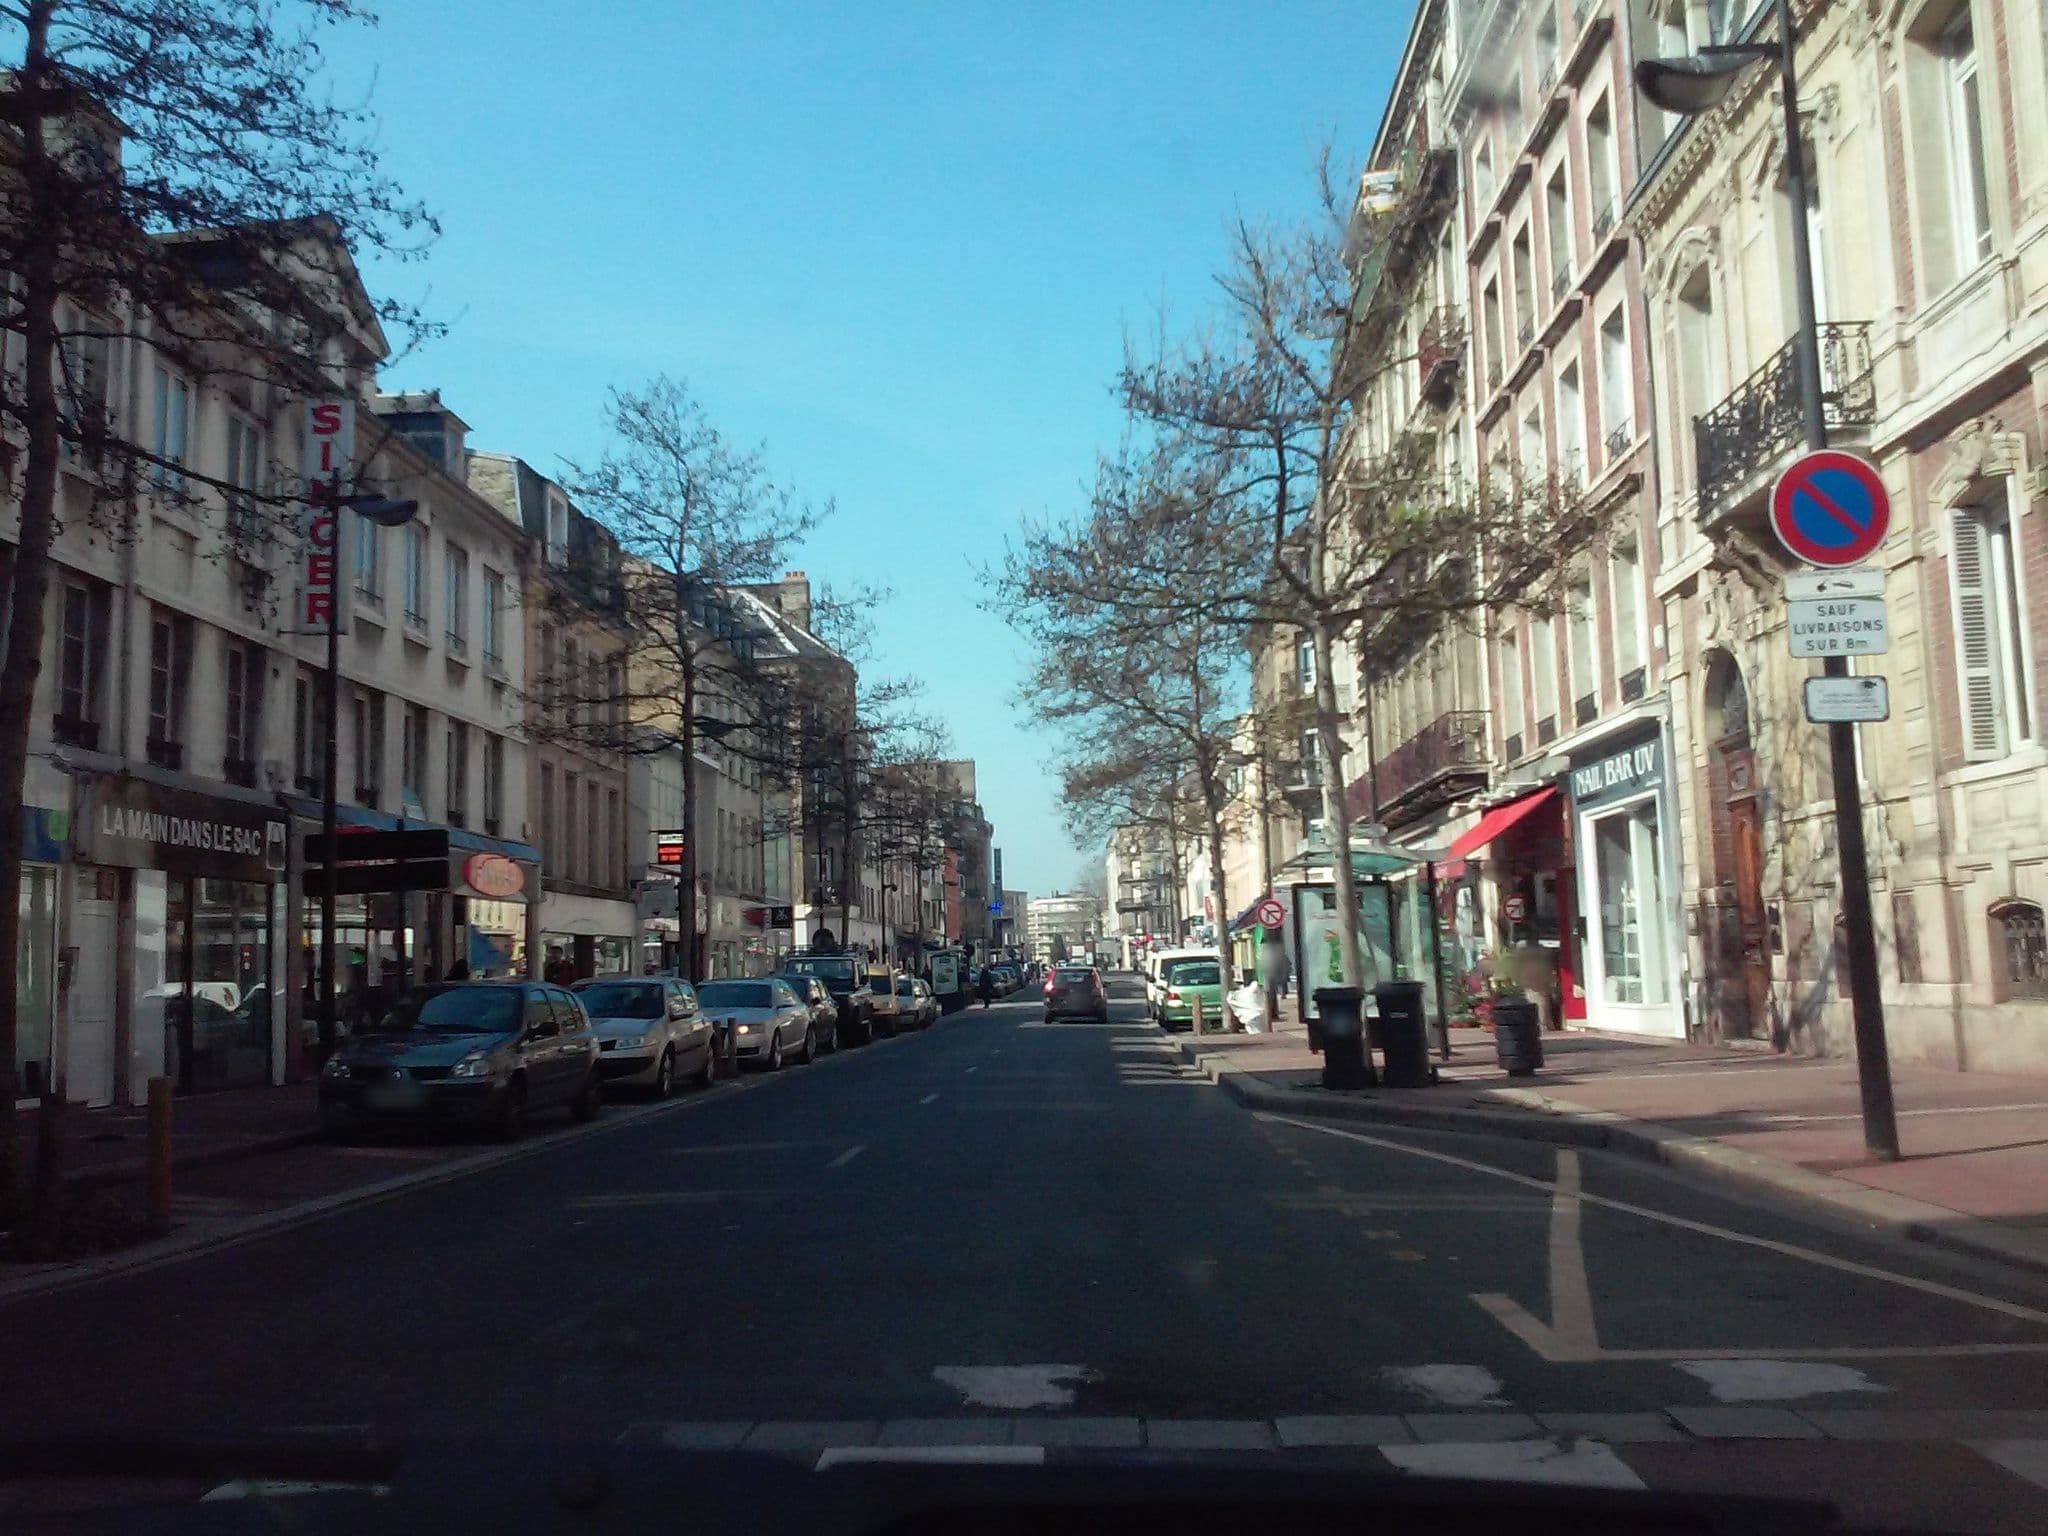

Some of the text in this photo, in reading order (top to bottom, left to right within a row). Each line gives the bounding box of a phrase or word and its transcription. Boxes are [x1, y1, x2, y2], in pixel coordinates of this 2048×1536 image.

[1817, 604, 1857, 617] SAUF
[1793, 619, 1884, 635] LIVRAISONS
[1806, 639, 1838, 651] SUR
[1575, 744, 1655, 796] NAIL BAR UV
[103, 805, 261, 856] LA MAIN DANS LE SAC
